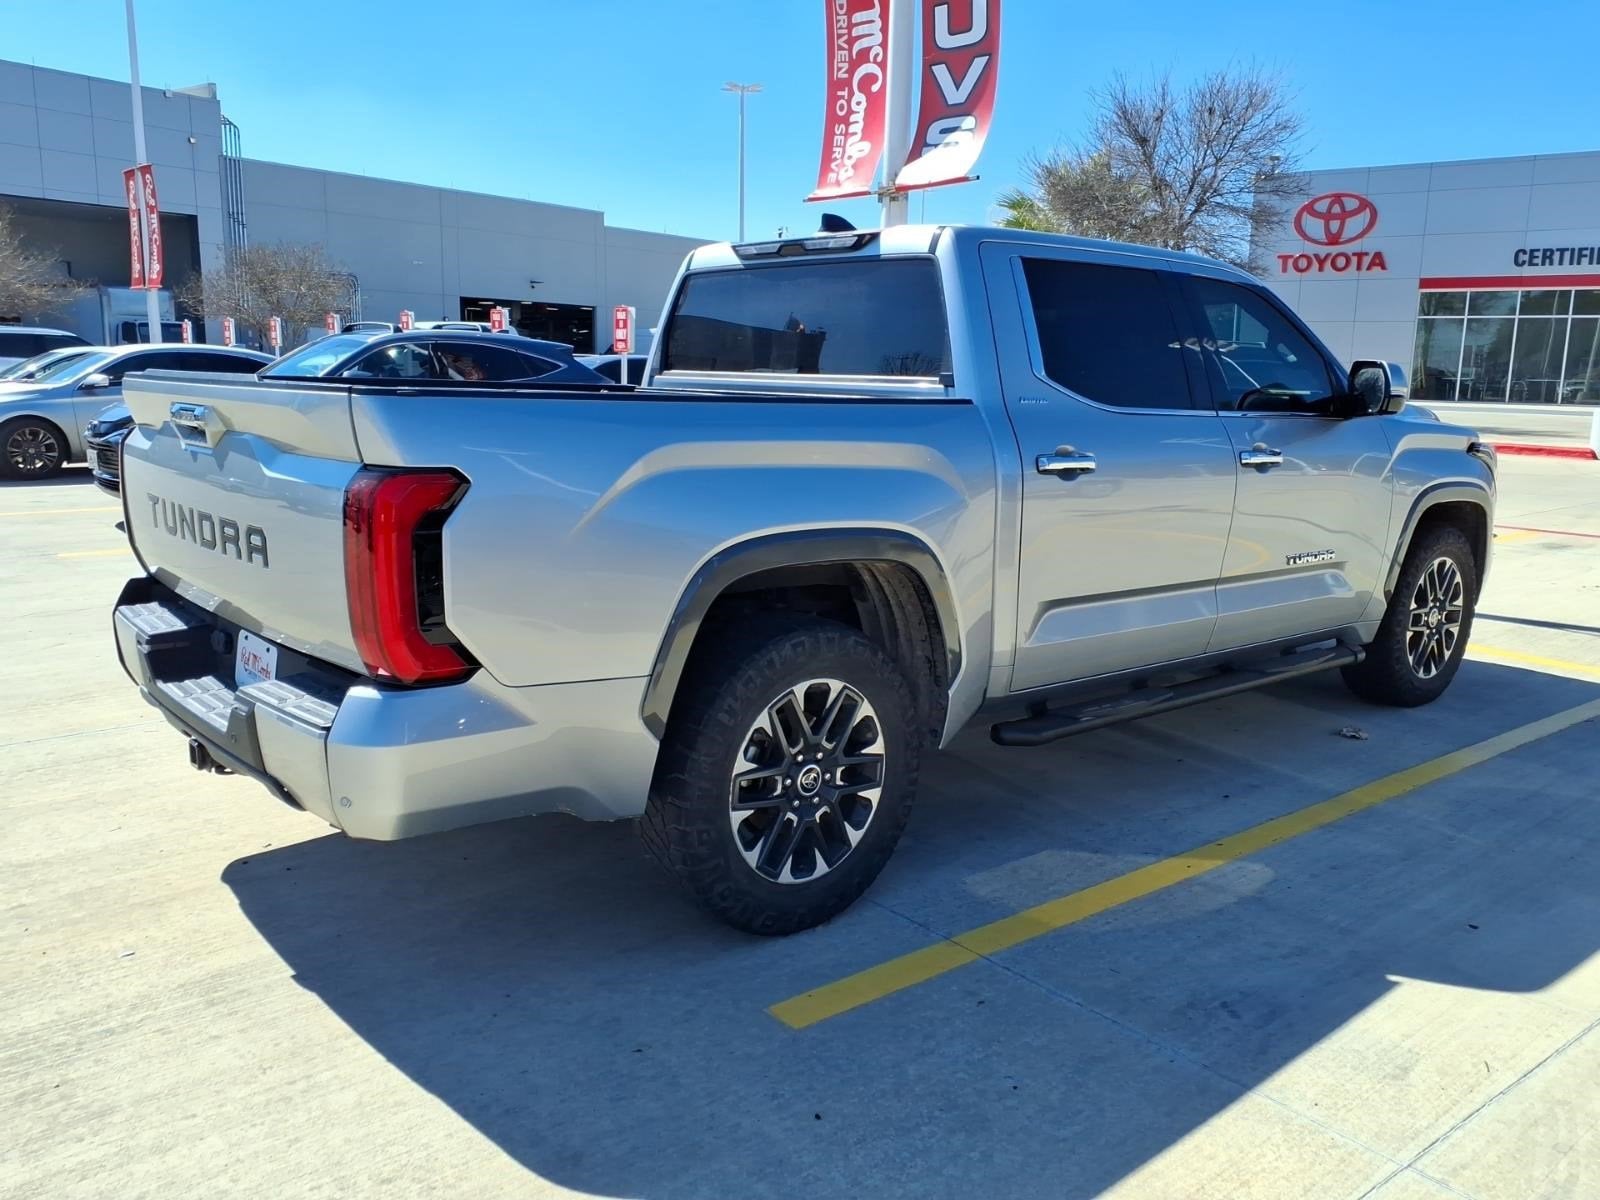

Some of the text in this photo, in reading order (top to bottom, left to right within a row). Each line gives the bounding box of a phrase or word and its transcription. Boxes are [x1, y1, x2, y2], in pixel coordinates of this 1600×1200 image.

[826, 0, 849, 184] DRIVEN TO SERVE
[838, 0, 883, 181] McCombs
[1277, 252, 1388, 273] TOYOTA
[146, 492, 269, 569] TUNDRA
[1286, 549, 1336, 565] TUNDRA
